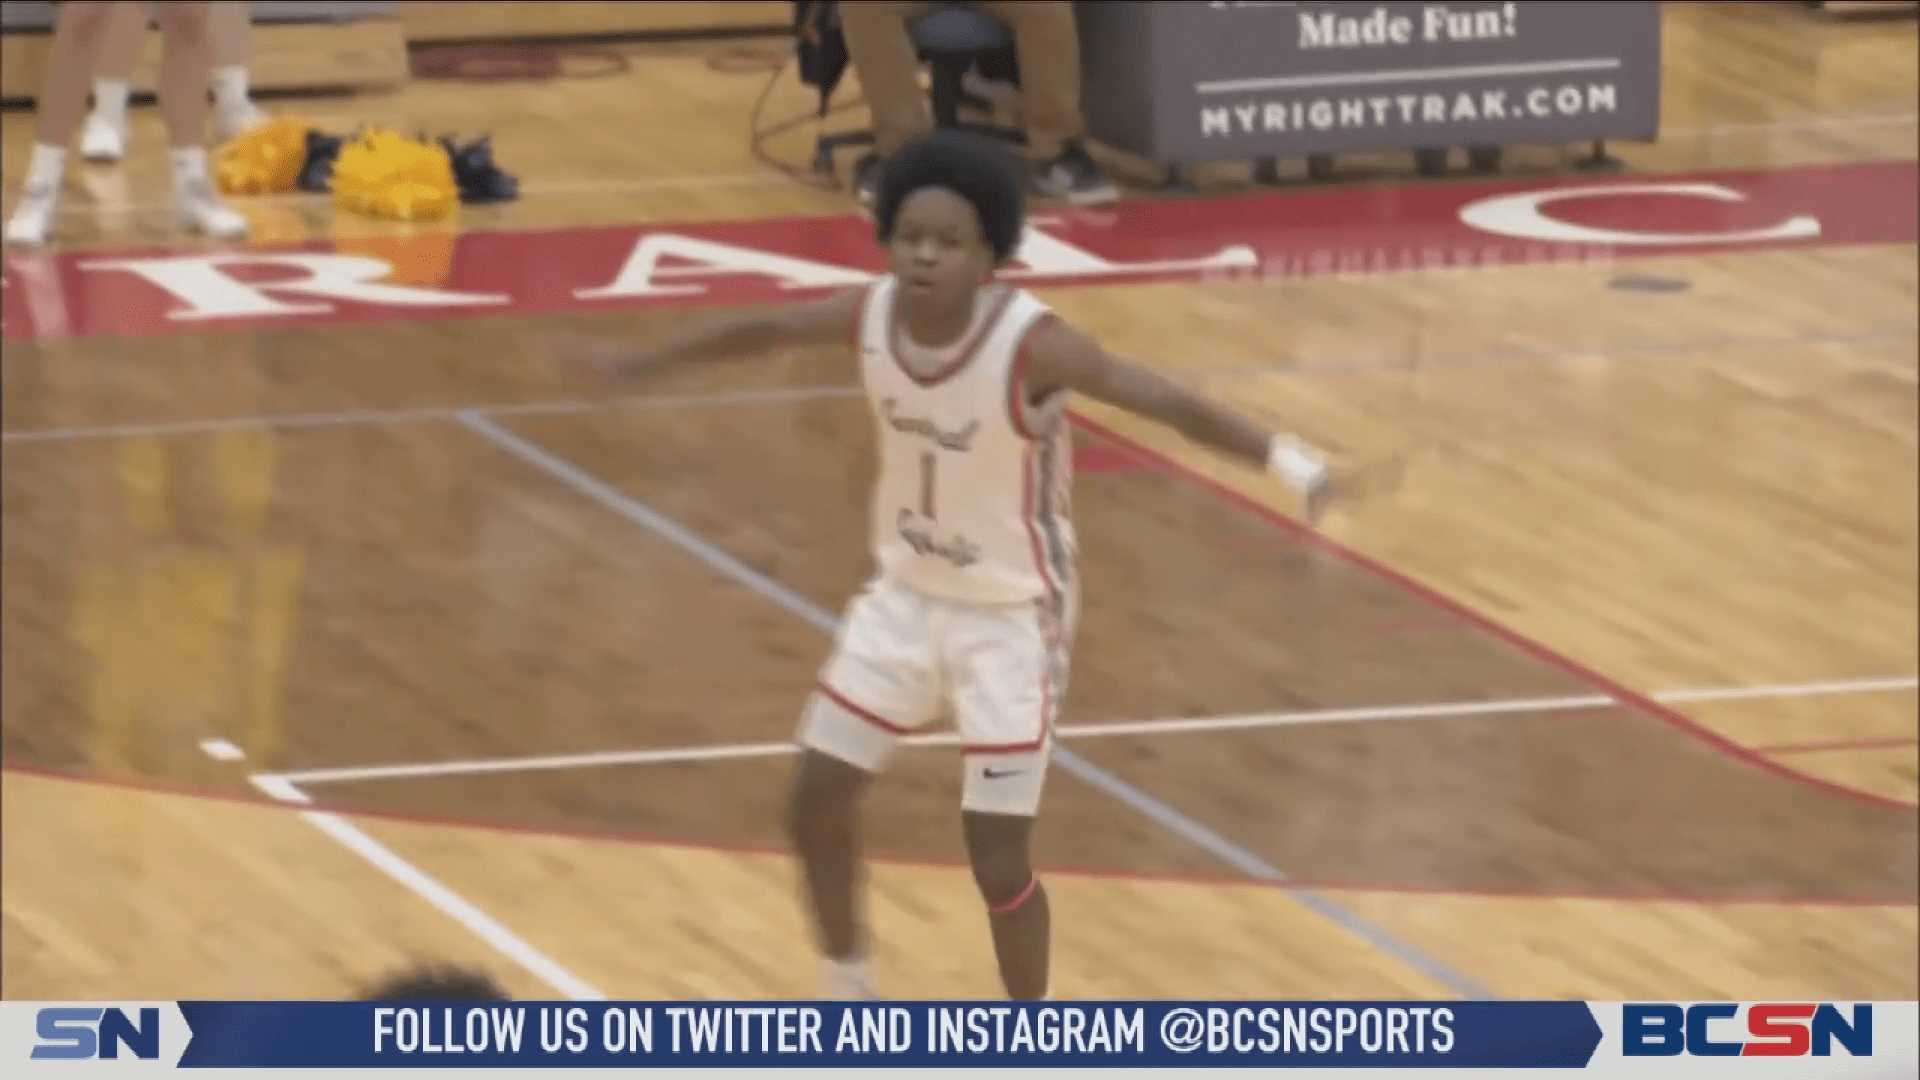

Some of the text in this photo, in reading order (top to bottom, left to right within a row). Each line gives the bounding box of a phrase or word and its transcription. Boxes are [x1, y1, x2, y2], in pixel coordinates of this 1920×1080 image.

[1298, 3, 1518, 50] Made Fun!
[1200, 84, 1617, 138] MYRIGHTTRAK.COM
